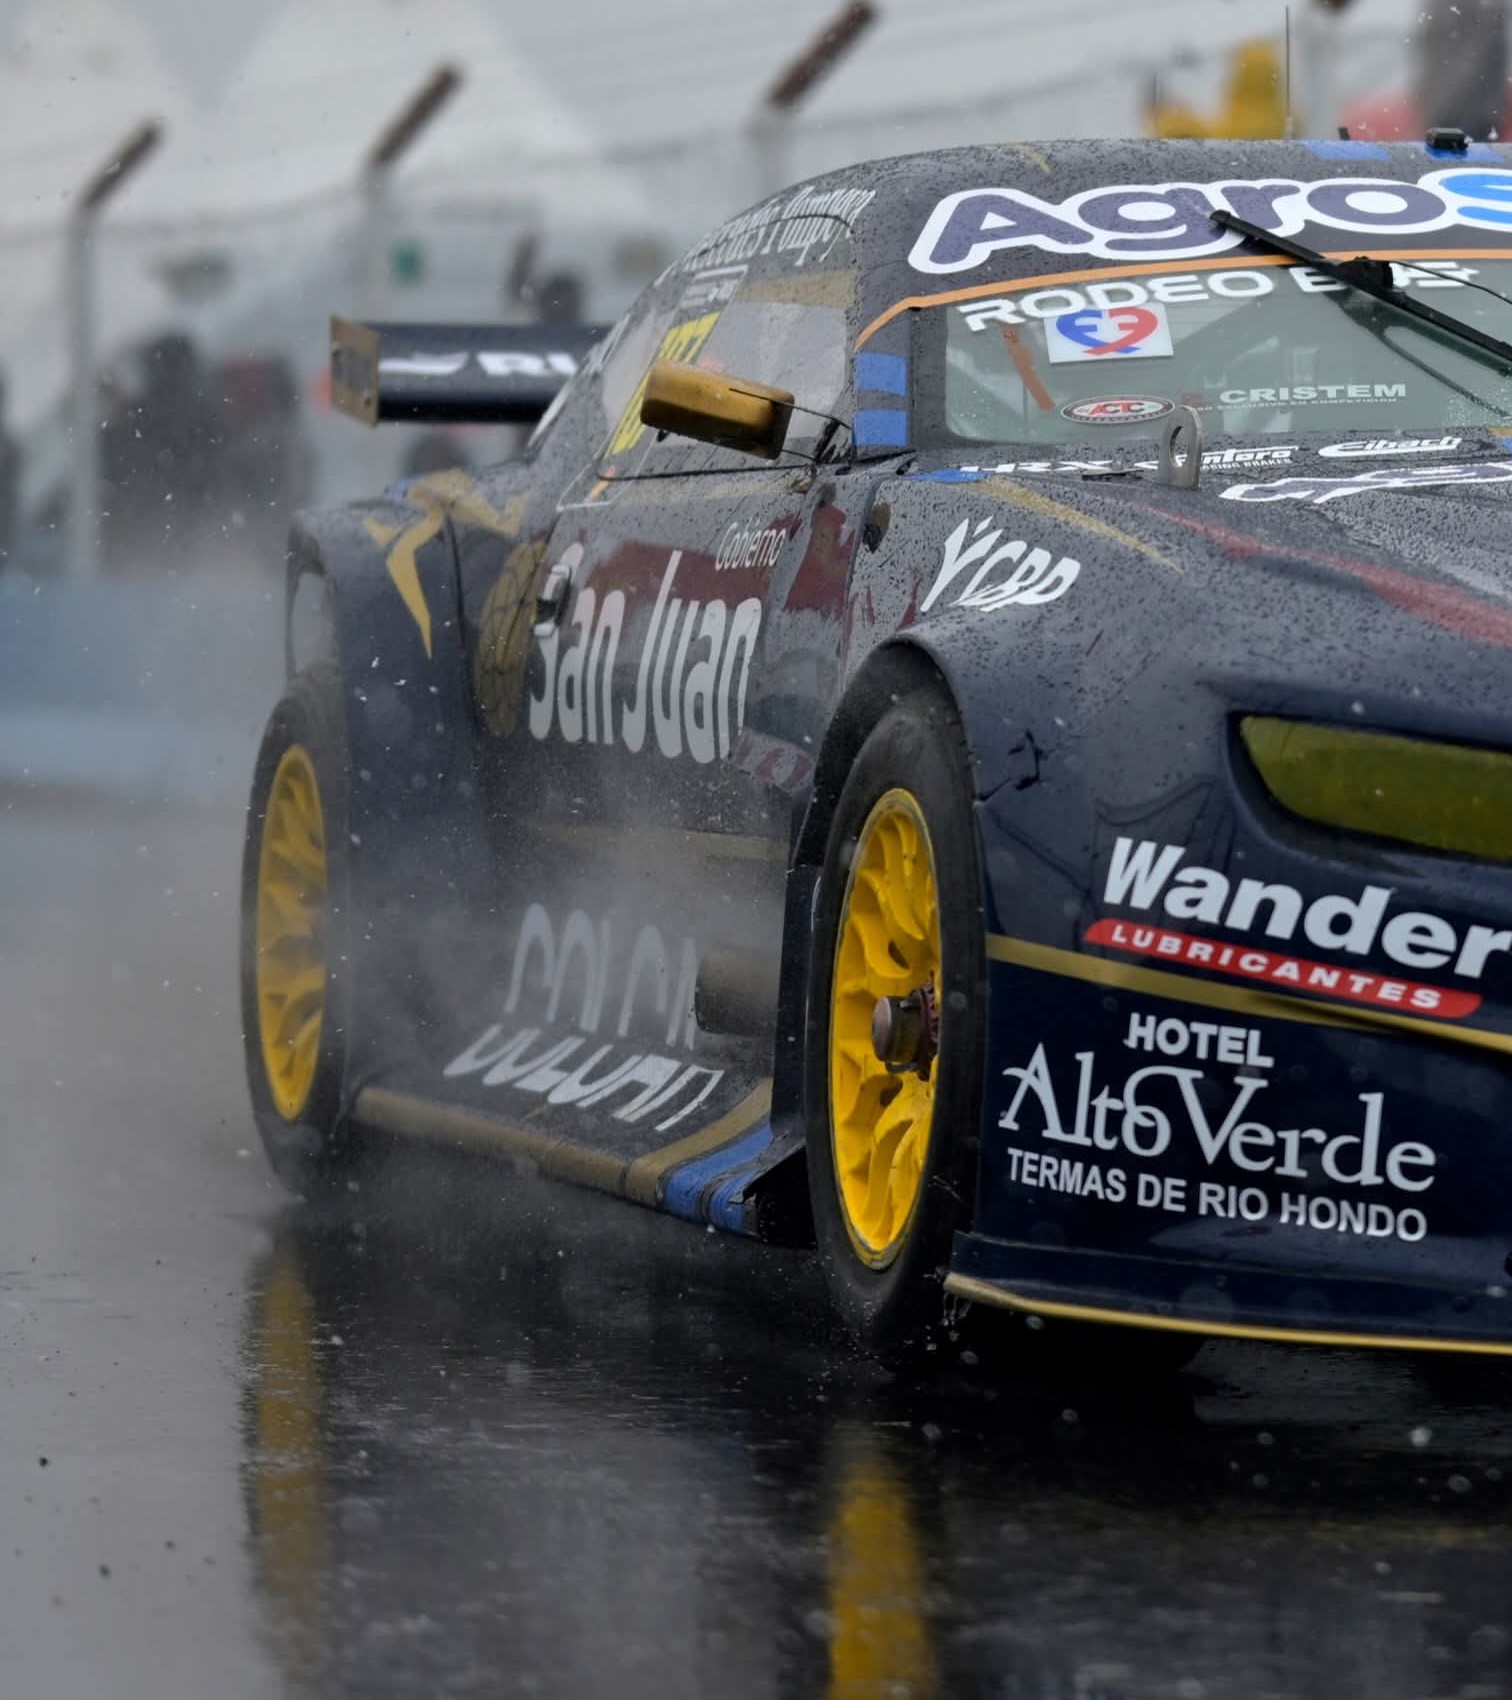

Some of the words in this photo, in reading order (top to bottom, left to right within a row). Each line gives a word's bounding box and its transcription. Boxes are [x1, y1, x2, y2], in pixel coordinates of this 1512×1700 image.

[958, 269, 1275, 332] RODEO
[1218, 384, 1407, 403] CRISTEM
[1318, 436, 1463, 457] Eibach
[715, 521, 786, 571] Gobierno
[528, 542, 626, 745] San
[622, 549, 762, 763] Juan
[1111, 924, 1442, 1010] LUBRICANTES
[1127, 1012, 1274, 1068] HOTEL
[1007, 1147, 1127, 1202] TERMAS
[1137, 1174, 1187, 1213] DE
[1199, 1181, 1269, 1222] RIO
[1279, 1193, 1428, 1242] HONDO
